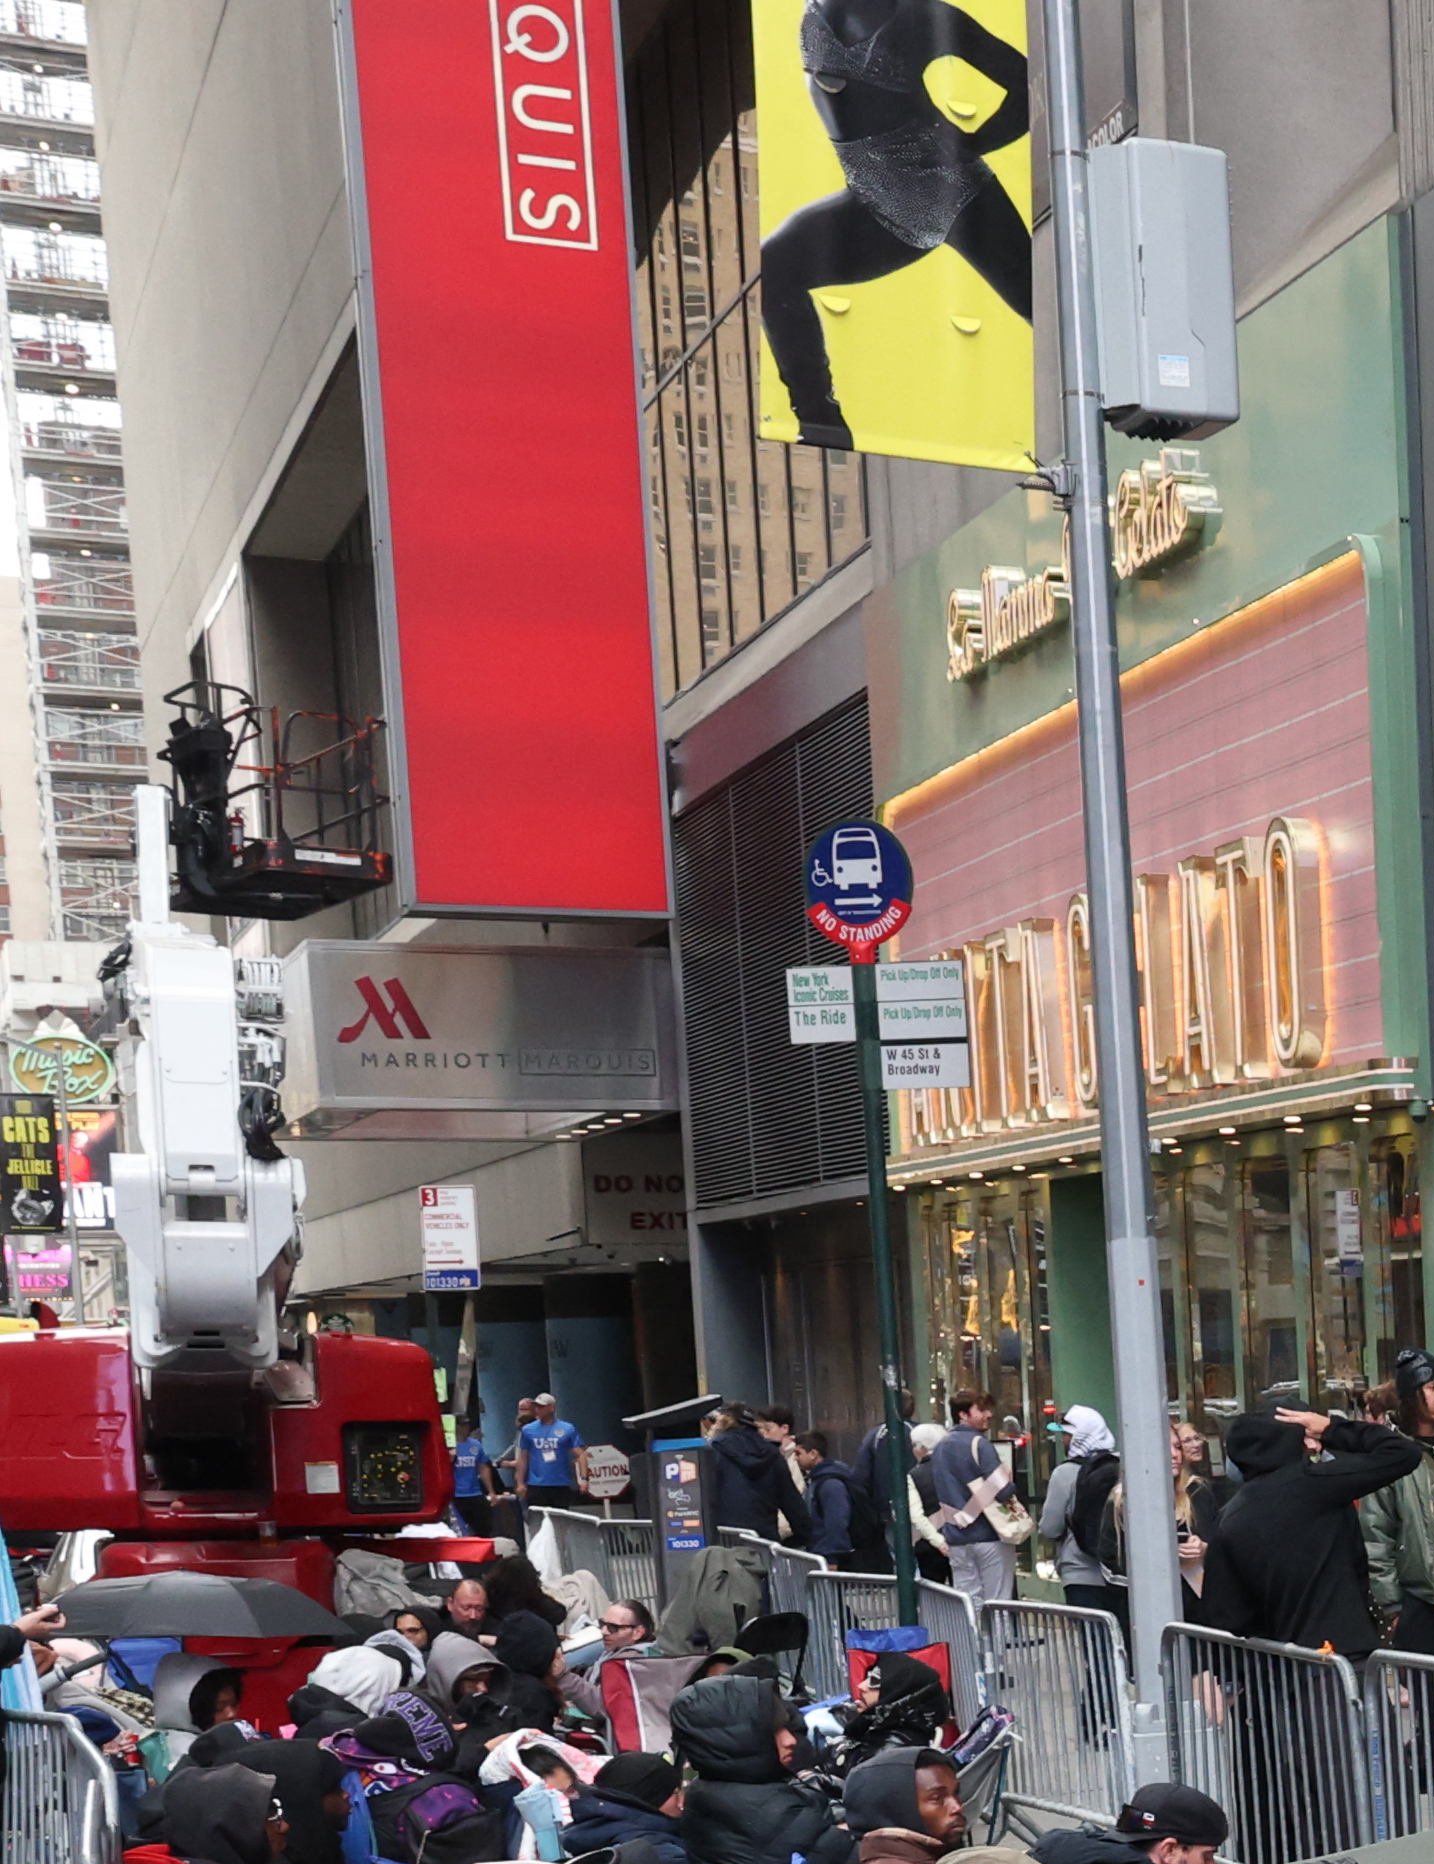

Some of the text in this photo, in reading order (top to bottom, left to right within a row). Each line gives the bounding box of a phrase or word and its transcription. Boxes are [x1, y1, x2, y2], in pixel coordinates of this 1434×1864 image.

[816, 905, 901, 942] NO STANDING
[1066, 818, 1312, 1105] GLATO
[792, 972, 829, 988] New York
[880, 968, 898, 982] Pick
[818, 987, 849, 1002] Cruises
[794, 1009, 847, 1026] The Ride
[883, 1007, 899, 1020] Pick
[360, 1051, 651, 1071] MARRIOTT MARQUIS
[886, 1047, 941, 1061] W 45 St &
[887, 1063, 940, 1077] Broadway
[2, 1116, 51, 1144] CATS
[6, 1158, 53, 1176] JELLICLE
[593, 1174, 634, 1195] DO
[424, 1188, 435, 1206] 3
[587, 1463, 630, 1479] AUTION
